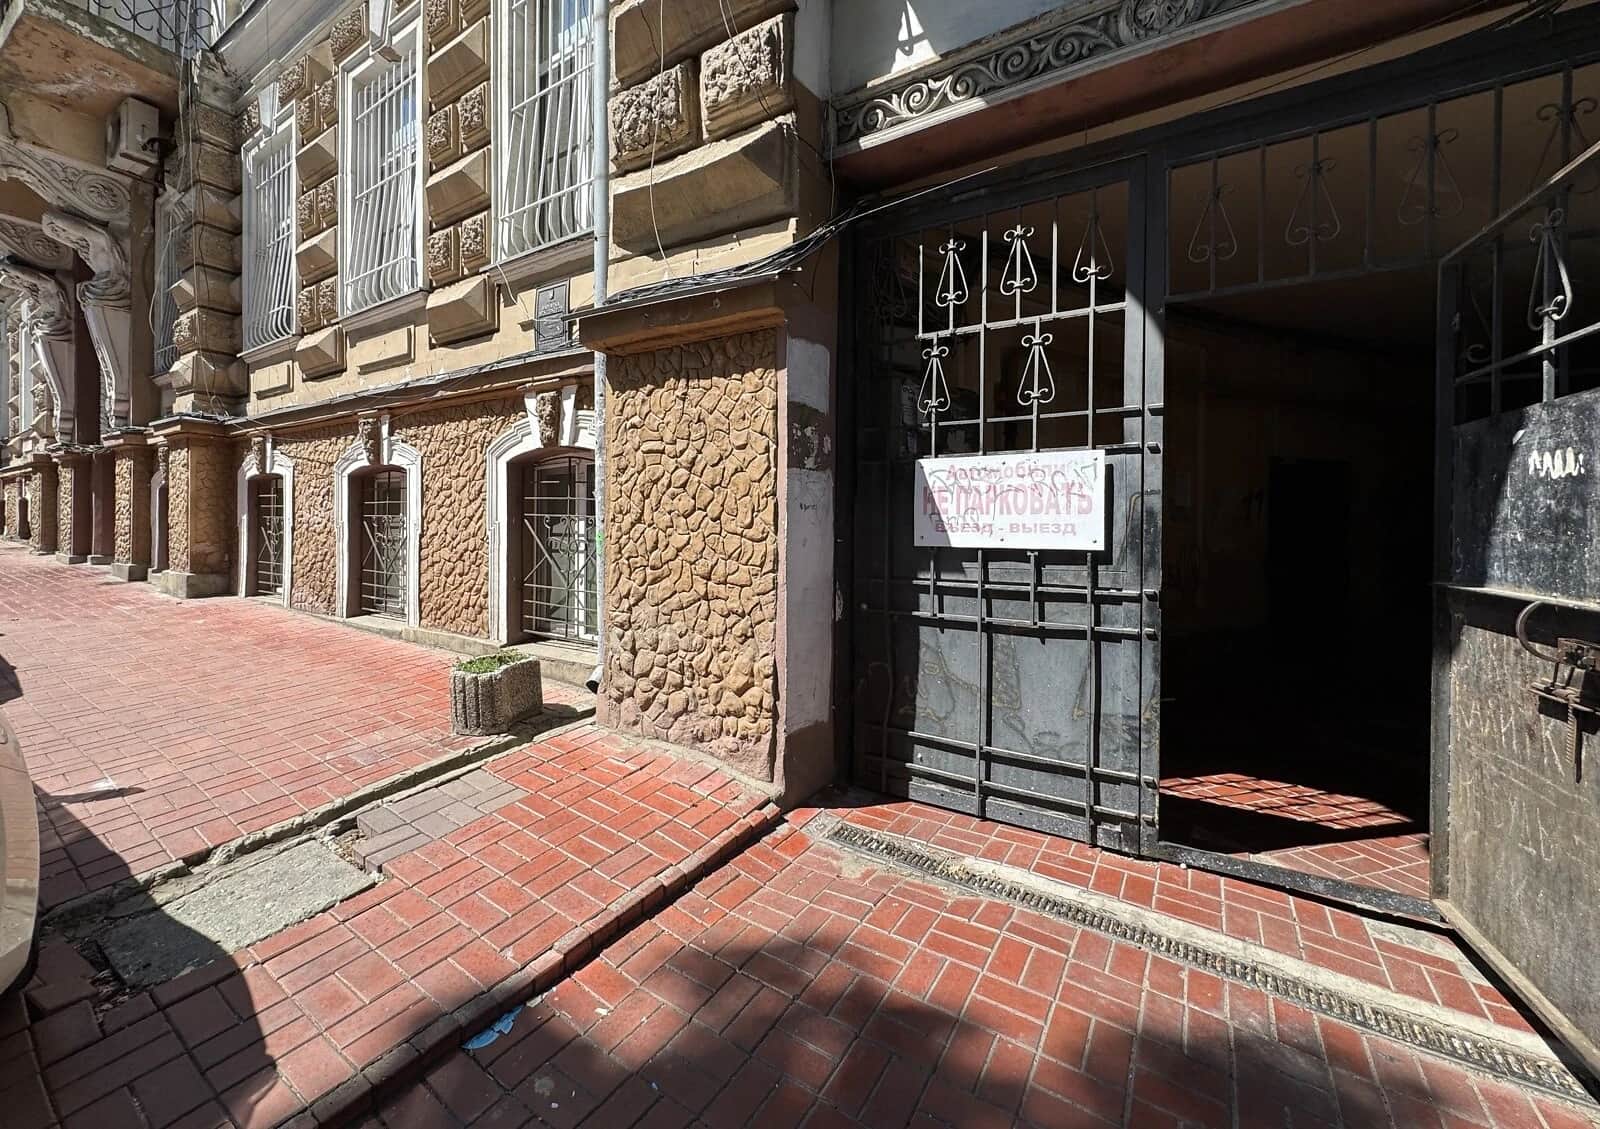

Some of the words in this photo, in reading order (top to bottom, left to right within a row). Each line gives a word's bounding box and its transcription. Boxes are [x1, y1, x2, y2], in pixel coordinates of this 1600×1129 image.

[922, 486, 949, 515] НЕ
[954, 483, 1094, 515] ПАРКОВАТЬ
[1008, 523, 1077, 537] ВЫЕЗД
